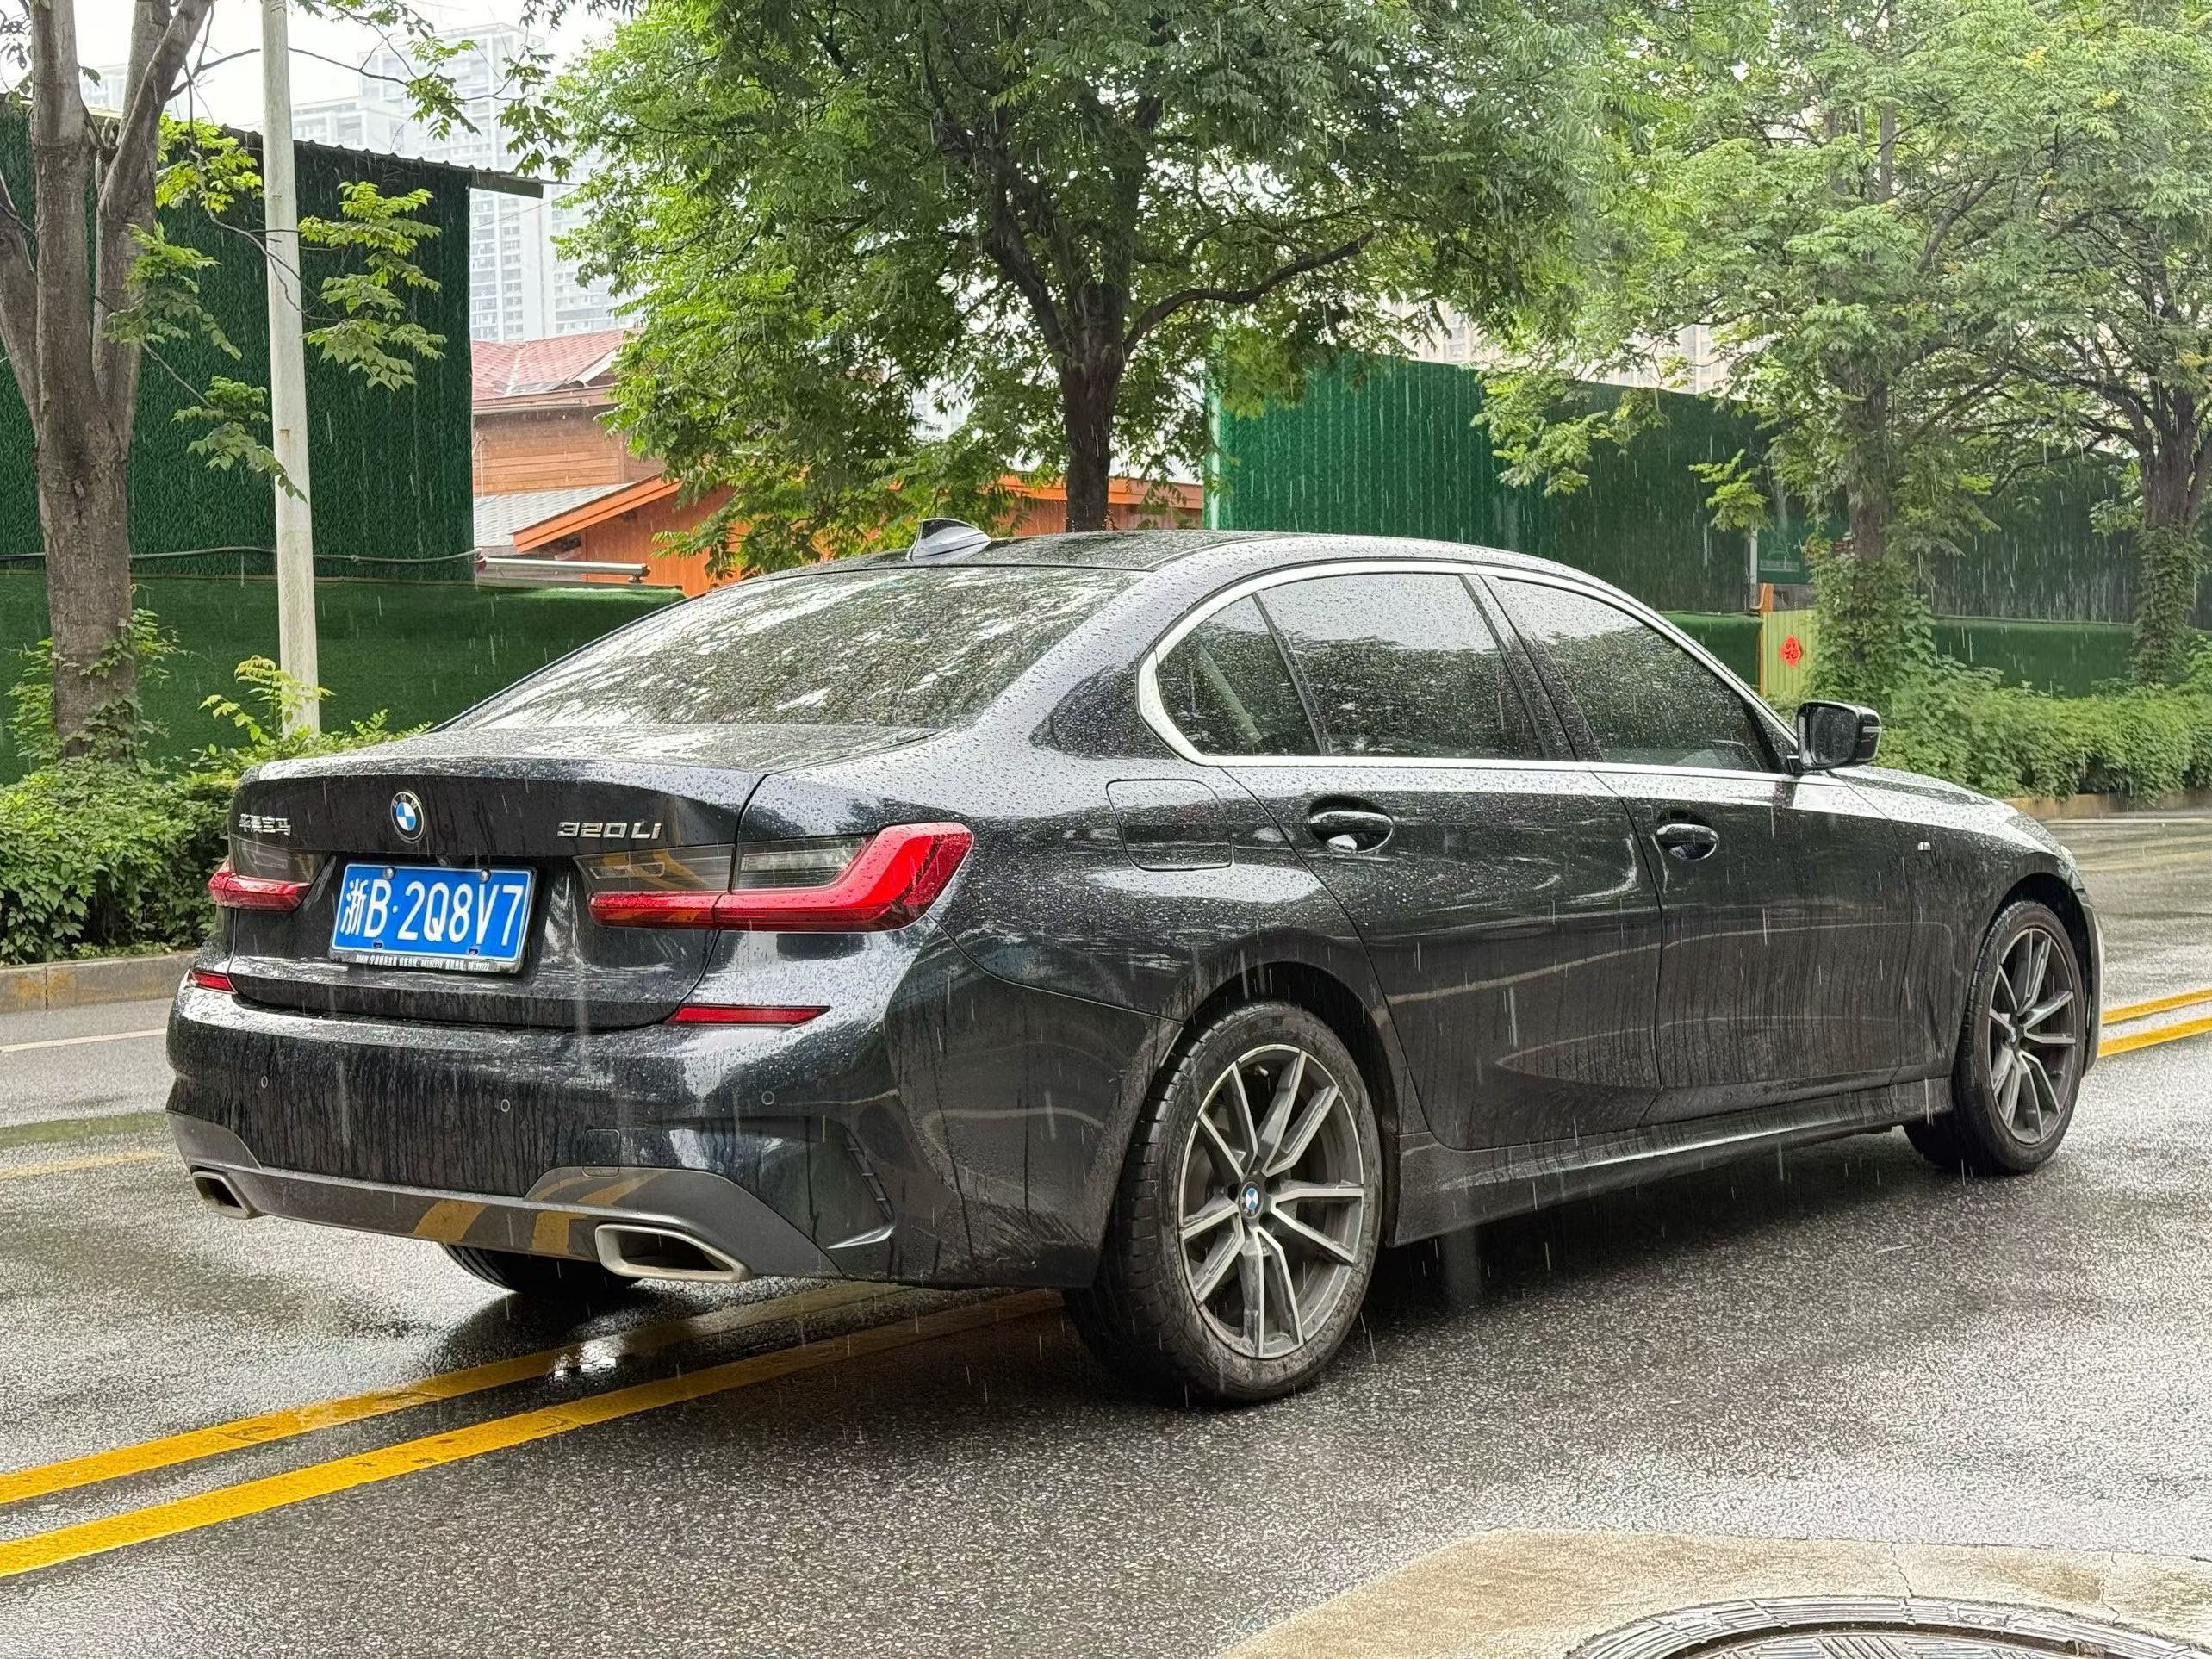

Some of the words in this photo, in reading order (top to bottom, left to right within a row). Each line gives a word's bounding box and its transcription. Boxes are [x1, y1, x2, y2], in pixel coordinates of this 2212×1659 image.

[239, 813, 292, 836] 华晨宝马
[557, 822, 662, 840] 320Li
